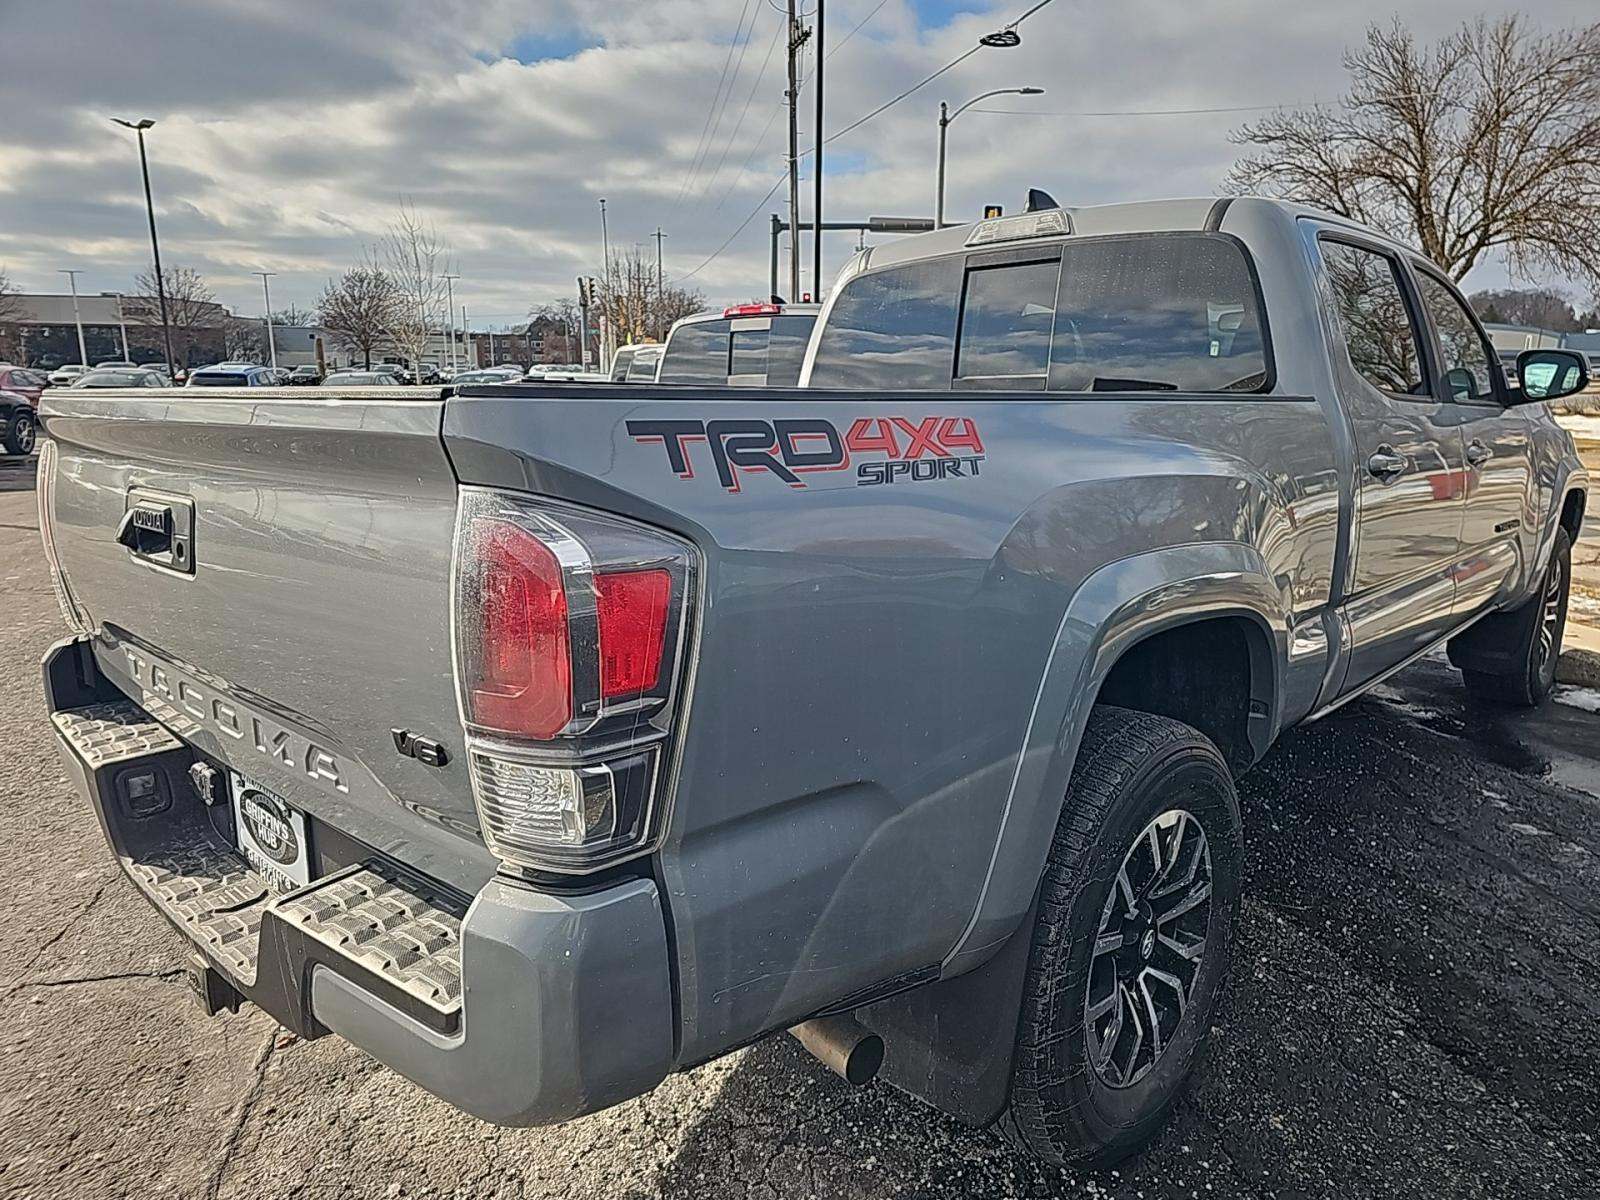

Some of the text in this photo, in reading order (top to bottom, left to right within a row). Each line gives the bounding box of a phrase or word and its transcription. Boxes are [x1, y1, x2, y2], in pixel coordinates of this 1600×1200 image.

[625, 419, 851, 494] TRD
[856, 455, 986, 487] SPORT
[127, 652, 350, 794] TACOMA
[390, 726, 450, 768] V6
[245, 798, 289, 841] GRIFFIN'S
[257, 823, 278, 850] HUB
